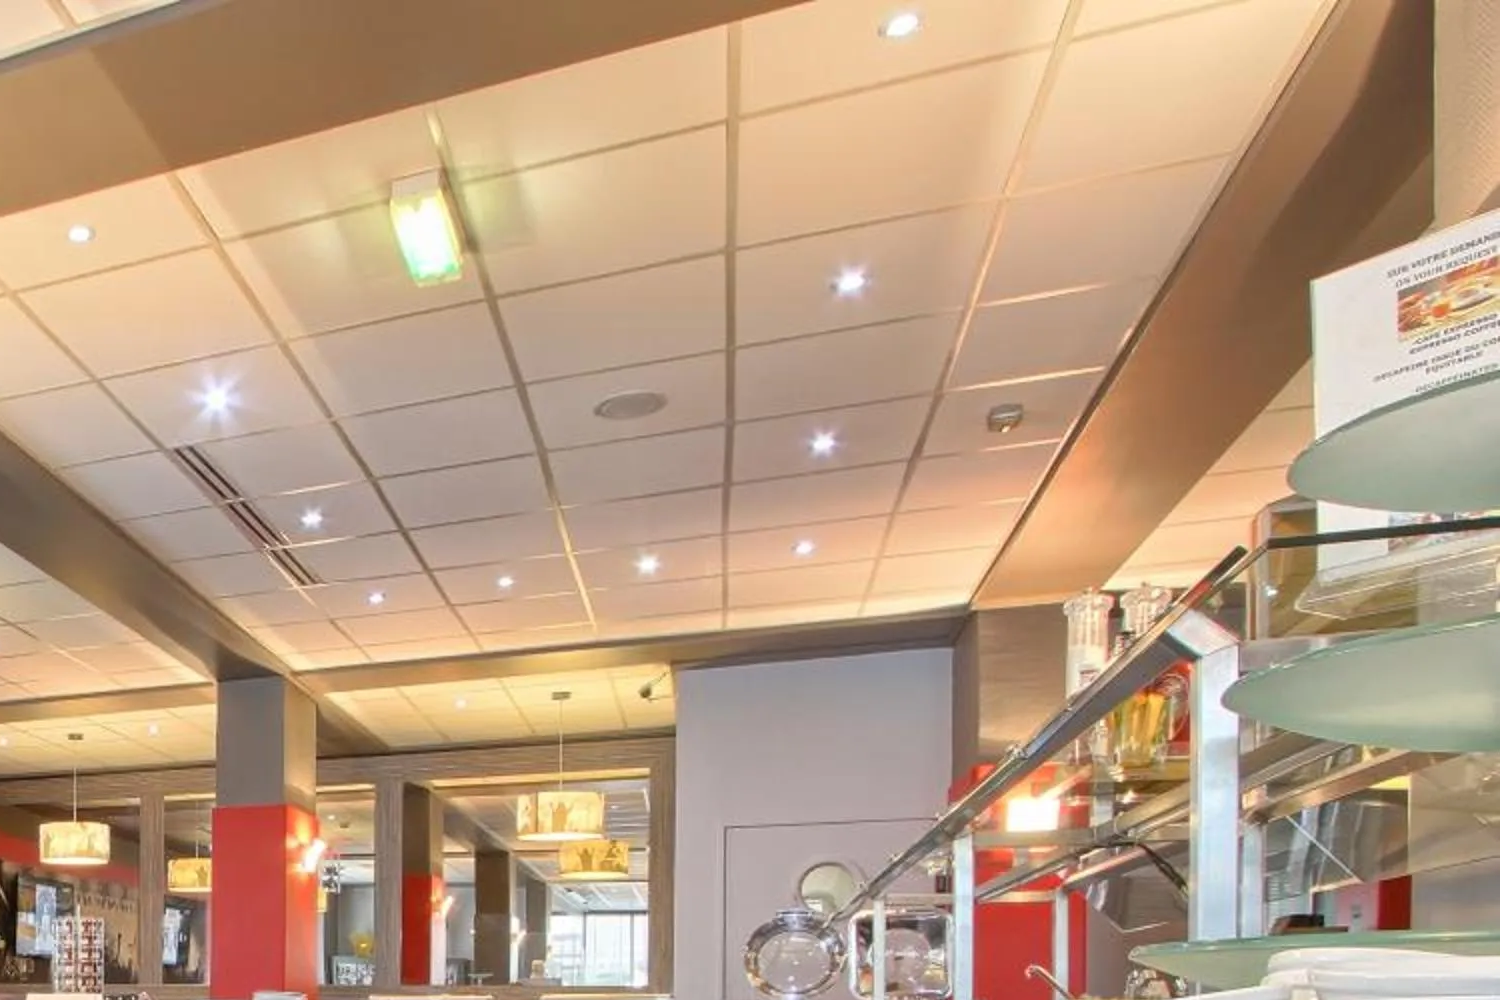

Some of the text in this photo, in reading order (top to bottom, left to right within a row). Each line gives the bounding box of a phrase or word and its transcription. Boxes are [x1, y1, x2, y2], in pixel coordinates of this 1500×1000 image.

[1411, 249, 1448, 268] VOTRE
[1395, 277, 1411, 289] ON
[1413, 265, 1443, 281] YOUR
